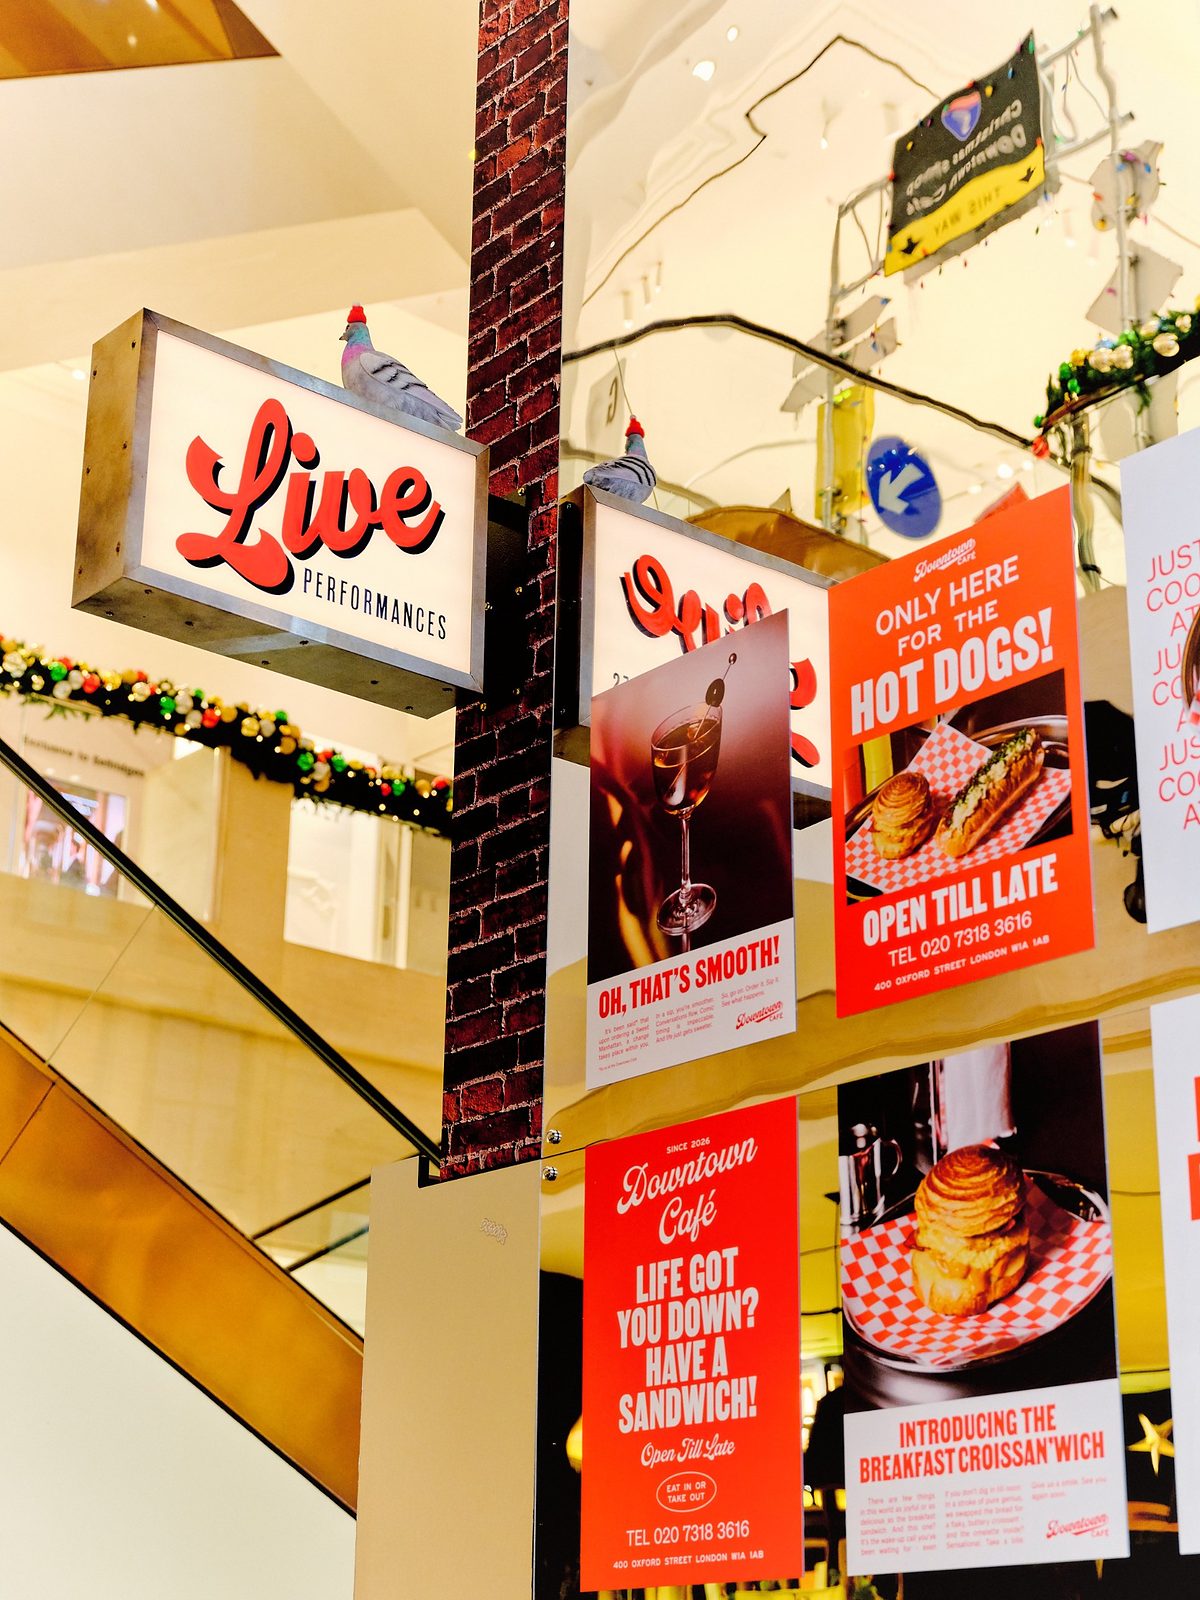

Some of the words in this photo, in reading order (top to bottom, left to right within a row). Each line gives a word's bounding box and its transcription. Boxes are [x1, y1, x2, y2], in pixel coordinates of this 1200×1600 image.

[176, 398, 446, 595] Live
[913, 537, 976, 583] Downtown
[303, 567, 447, 640] PERFORMANCES
[875, 587, 941, 636] ONLY
[950, 555, 1020, 607] HERE
[898, 623, 942, 657] FOR
[954, 599, 999, 632] THE
[851, 658, 924, 736] HOT
[934, 607, 1053, 705] DOGS!
[862, 894, 927, 947] OPEN
[931, 877, 988, 926] TILL
[993, 853, 1058, 909] LATE
[888, 946, 917, 967] TEL
[920, 935, 950, 958] 020
[954, 922, 991, 948] 7318
[994, 910, 1032, 937] 3616
[598, 986, 627, 1020] OH,
[629, 964, 690, 1009] THAT'S
[695, 935, 780, 989] SMOOTH!
[874, 980, 892, 991] 400
[895, 969, 930, 986] OXFORD
[934, 959, 966, 975] STREET
[970, 947, 1007, 965] LONDON
[735, 1000, 783, 1030] Downtown
[666, 1142, 688, 1154] SINCE
[691, 1136, 711, 1149] 2026
[617, 1136, 759, 1215] Downtown
[658, 1188, 717, 1245] Café
[636, 1257, 684, 1304] LIFE
[689, 1246, 739, 1294] GOT
[617, 1304, 661, 1349] YOU
[667, 1287, 759, 1341] DOWN?
[646, 1339, 706, 1387] HAVE
[712, 1336, 729, 1378] A
[618, 1375, 758, 1435] SANDWICH!
[899, 1409, 1017, 1448] INTRODUCING
[1021, 1404, 1056, 1433] THE
[641, 1441, 677, 1469] Open
[677, 1437, 703, 1463] Till
[703, 1433, 736, 1461] Late
[859, 1448, 955, 1484] BREAKFAST
[959, 1431, 1105, 1473] CROISSAN'WICH
[666, 1483, 680, 1493] EAT
[684, 1482, 692, 1491] IN
[695, 1481, 707, 1490] OR
[667, 1493, 686, 1503] TAKE
[689, 1492, 705, 1502] OUT
[626, 1529, 650, 1547] TEL
[654, 1526, 679, 1545] 020
[682, 1523, 713, 1542] 7318
[717, 1519, 750, 1539] 3616
[1046, 1513, 1109, 1539] Downtown
[613, 1559, 628, 1569] 400
[631, 1557, 661, 1568] OXFORD
[664, 1555, 692, 1565] STREET
[696, 1552, 728, 1564] LONDON
